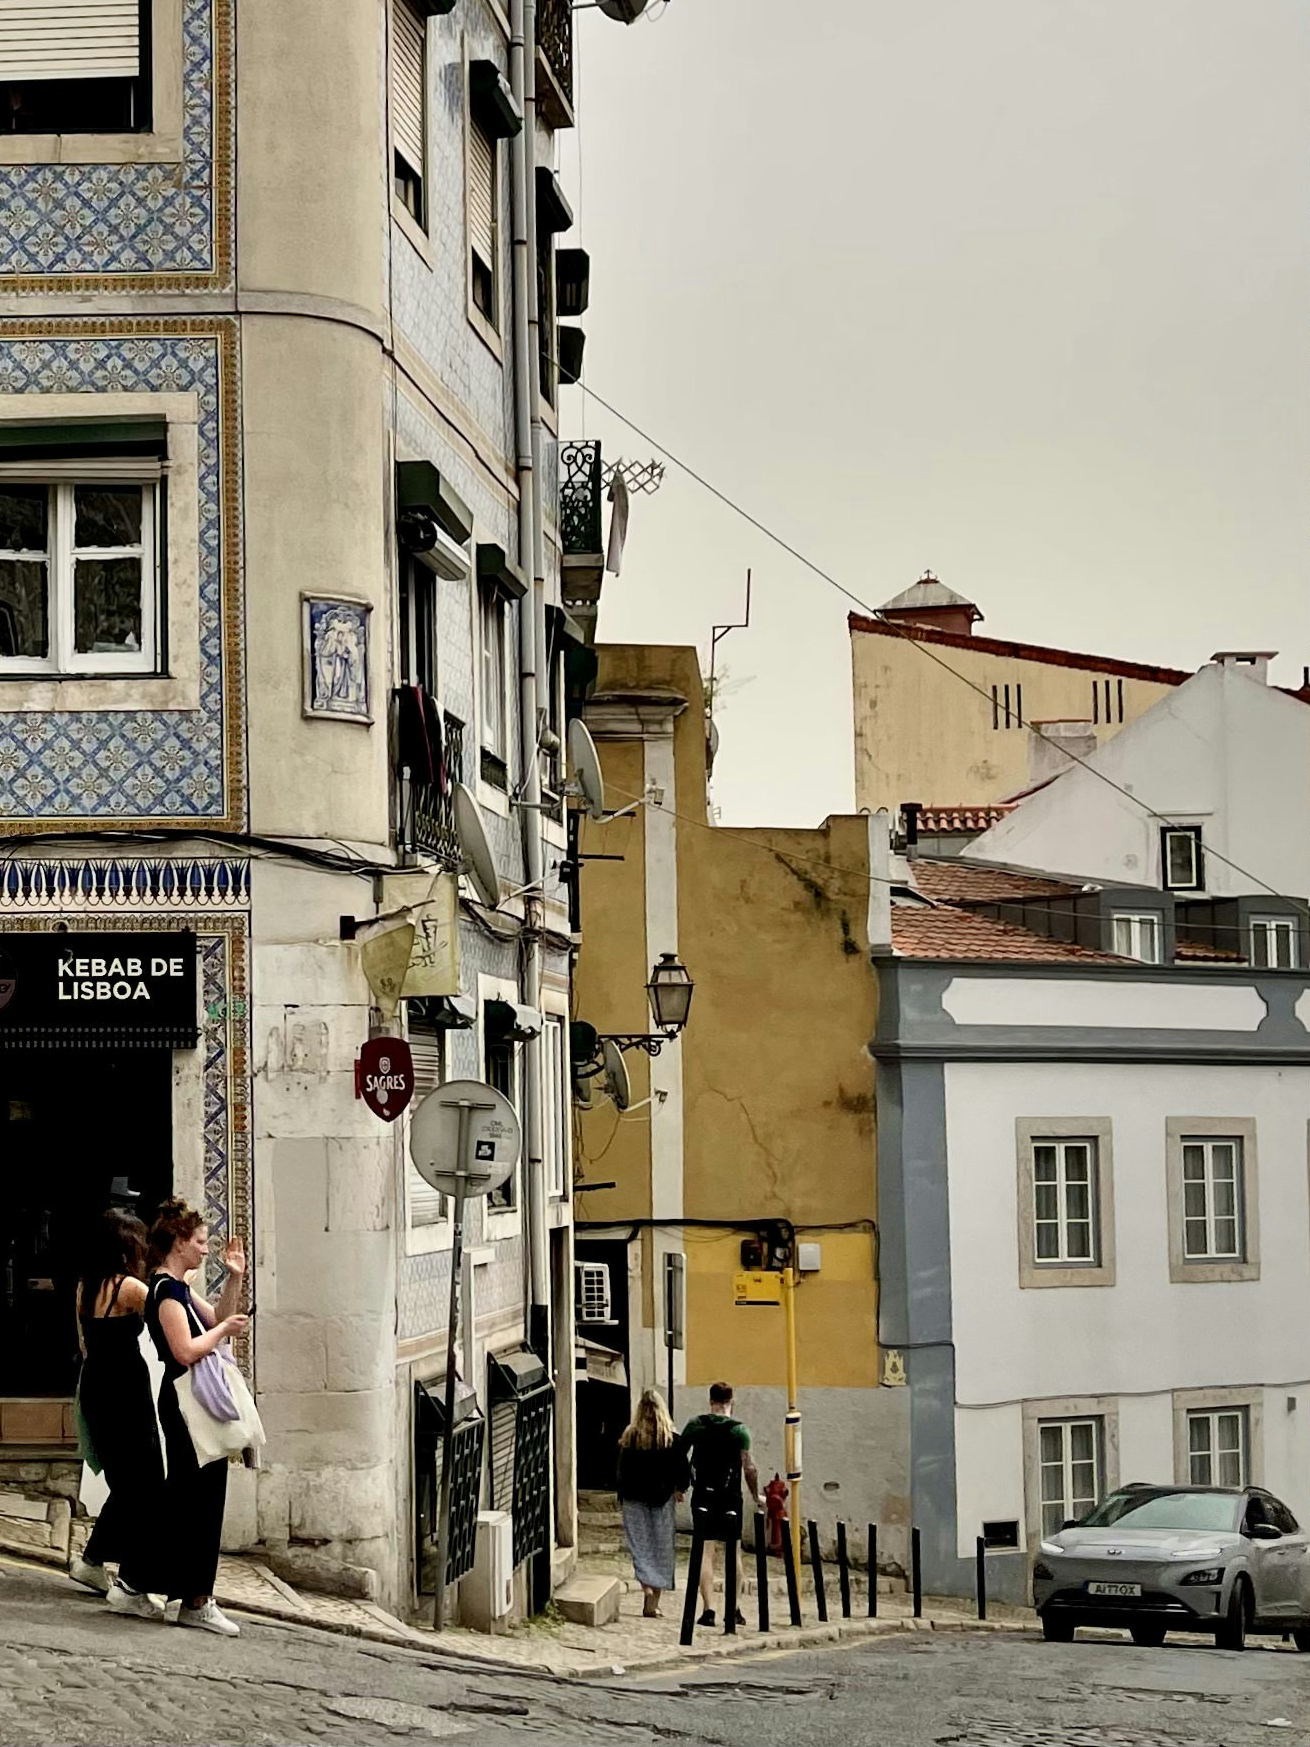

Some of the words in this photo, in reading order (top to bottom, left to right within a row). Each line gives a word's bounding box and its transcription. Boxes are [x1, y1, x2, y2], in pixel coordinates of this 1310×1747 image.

[57, 958, 143, 977] KEBAB
[150, 958, 184, 976] DE
[57, 981, 151, 1000] LISBOA
[365, 1074, 406, 1092] SAGRES
